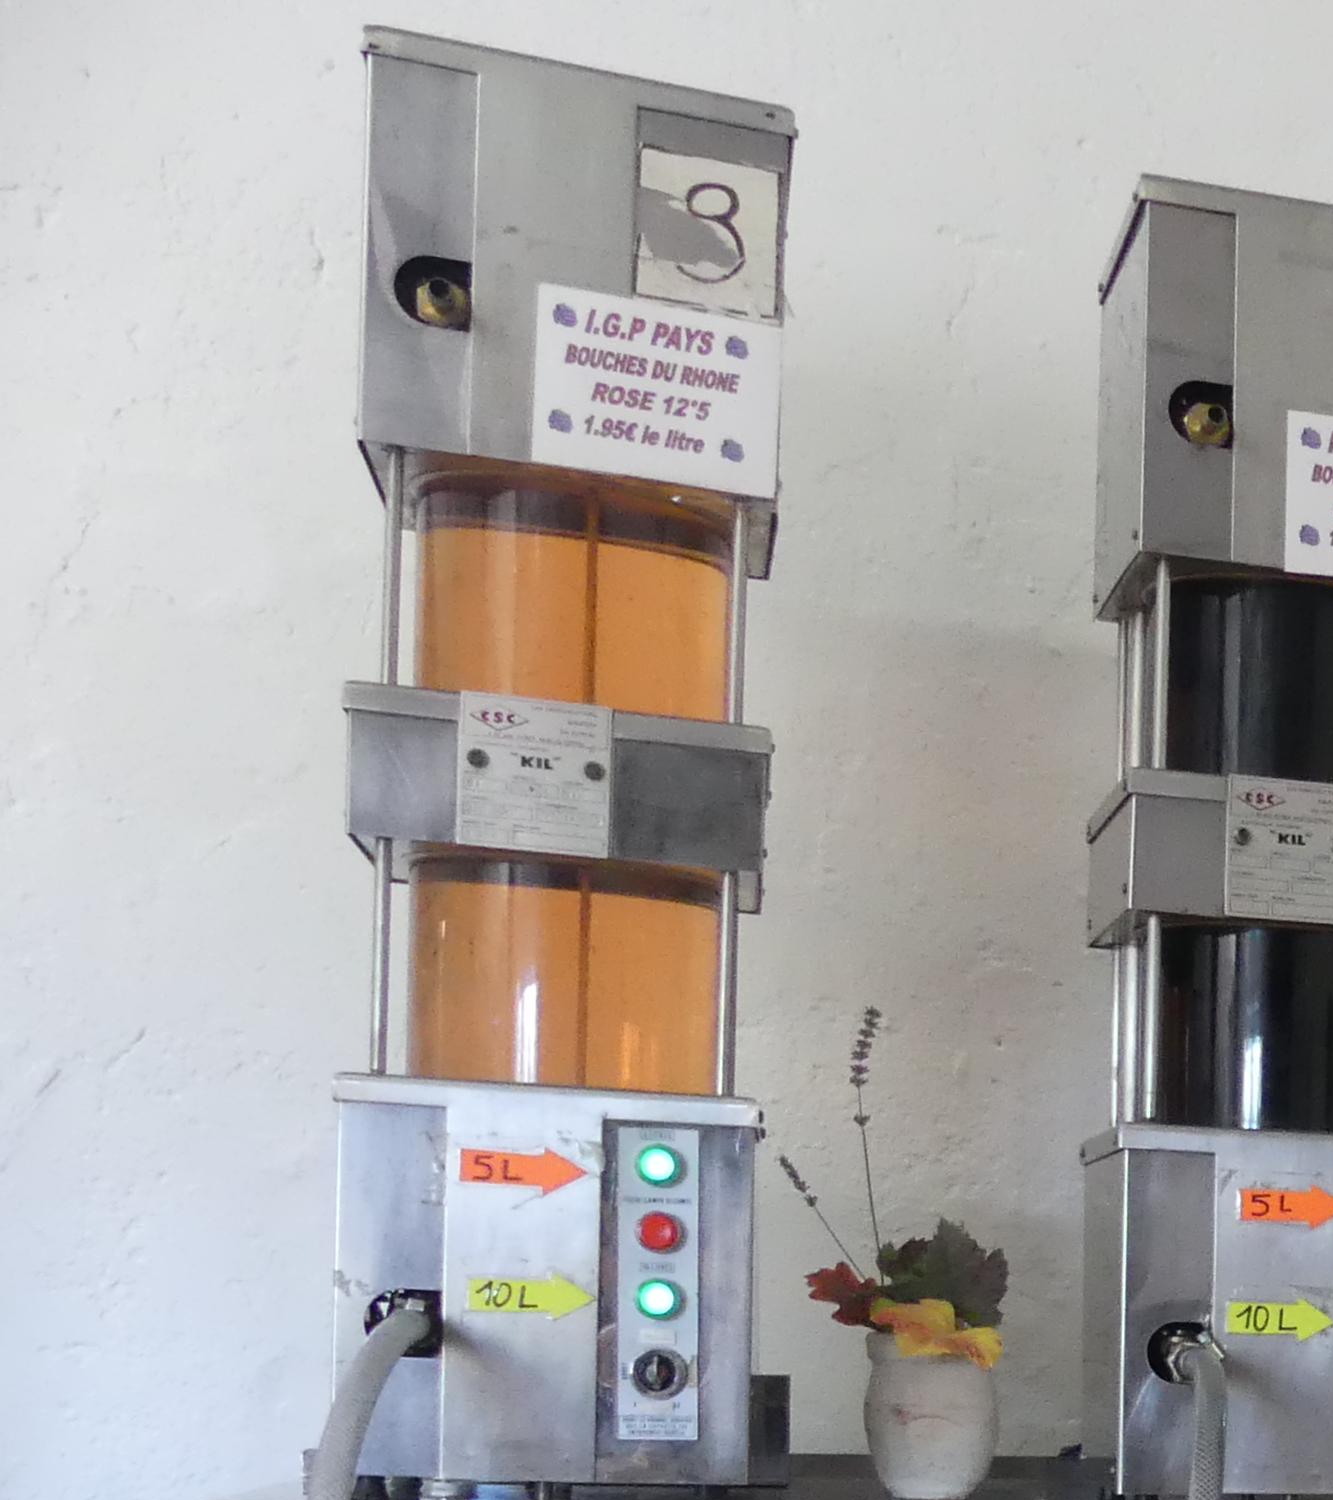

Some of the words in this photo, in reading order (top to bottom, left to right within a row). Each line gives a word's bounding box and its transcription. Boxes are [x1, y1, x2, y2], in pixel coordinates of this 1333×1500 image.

[585, 309, 646, 342] I.G.P
[651, 321, 714, 356] PAYS
[565, 343, 648, 378] BOUCHES
[651, 360, 677, 382] DU
[680, 366, 740, 394] RHONE
[591, 382, 656, 411] ROSE
[641, 425, 660, 446] le
[664, 429, 705, 454] litre
